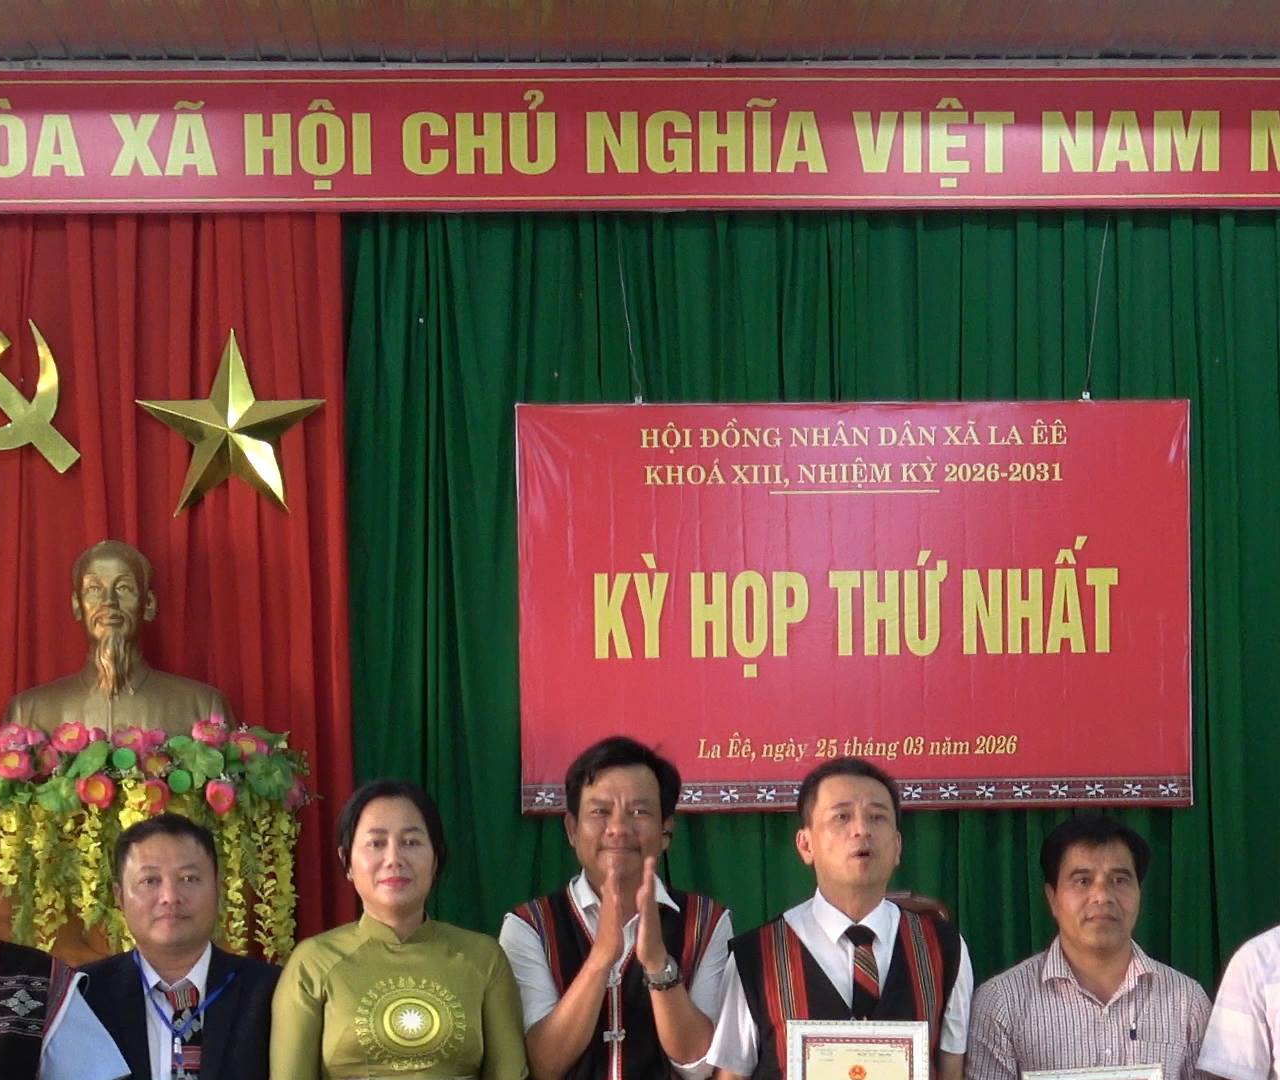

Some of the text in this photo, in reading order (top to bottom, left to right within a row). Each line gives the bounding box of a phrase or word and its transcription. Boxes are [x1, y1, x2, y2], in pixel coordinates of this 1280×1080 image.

[114, 100, 216, 177] XÃ
[244, 99, 372, 190] HỘI
[402, 89, 556, 176] CHỦ
[586, 98, 827, 175] NGHĨA
[853, 97, 1015, 188] VIỆT
[1043, 110, 1221, 173] NAM
[640, 418, 1067, 454] HỘI ĐỒNG NHÂN DÂN XÃ LA ÊÊ
[644, 456, 1064, 489] KHOÁ XIII, NHIỆM KỲ 2026-2031
[593, 535, 1119, 679] KỲ HỌP THỨ NHẤT
[697, 732, 1018, 763] La Êê, ngày 25 tháng 03 năm 2026
